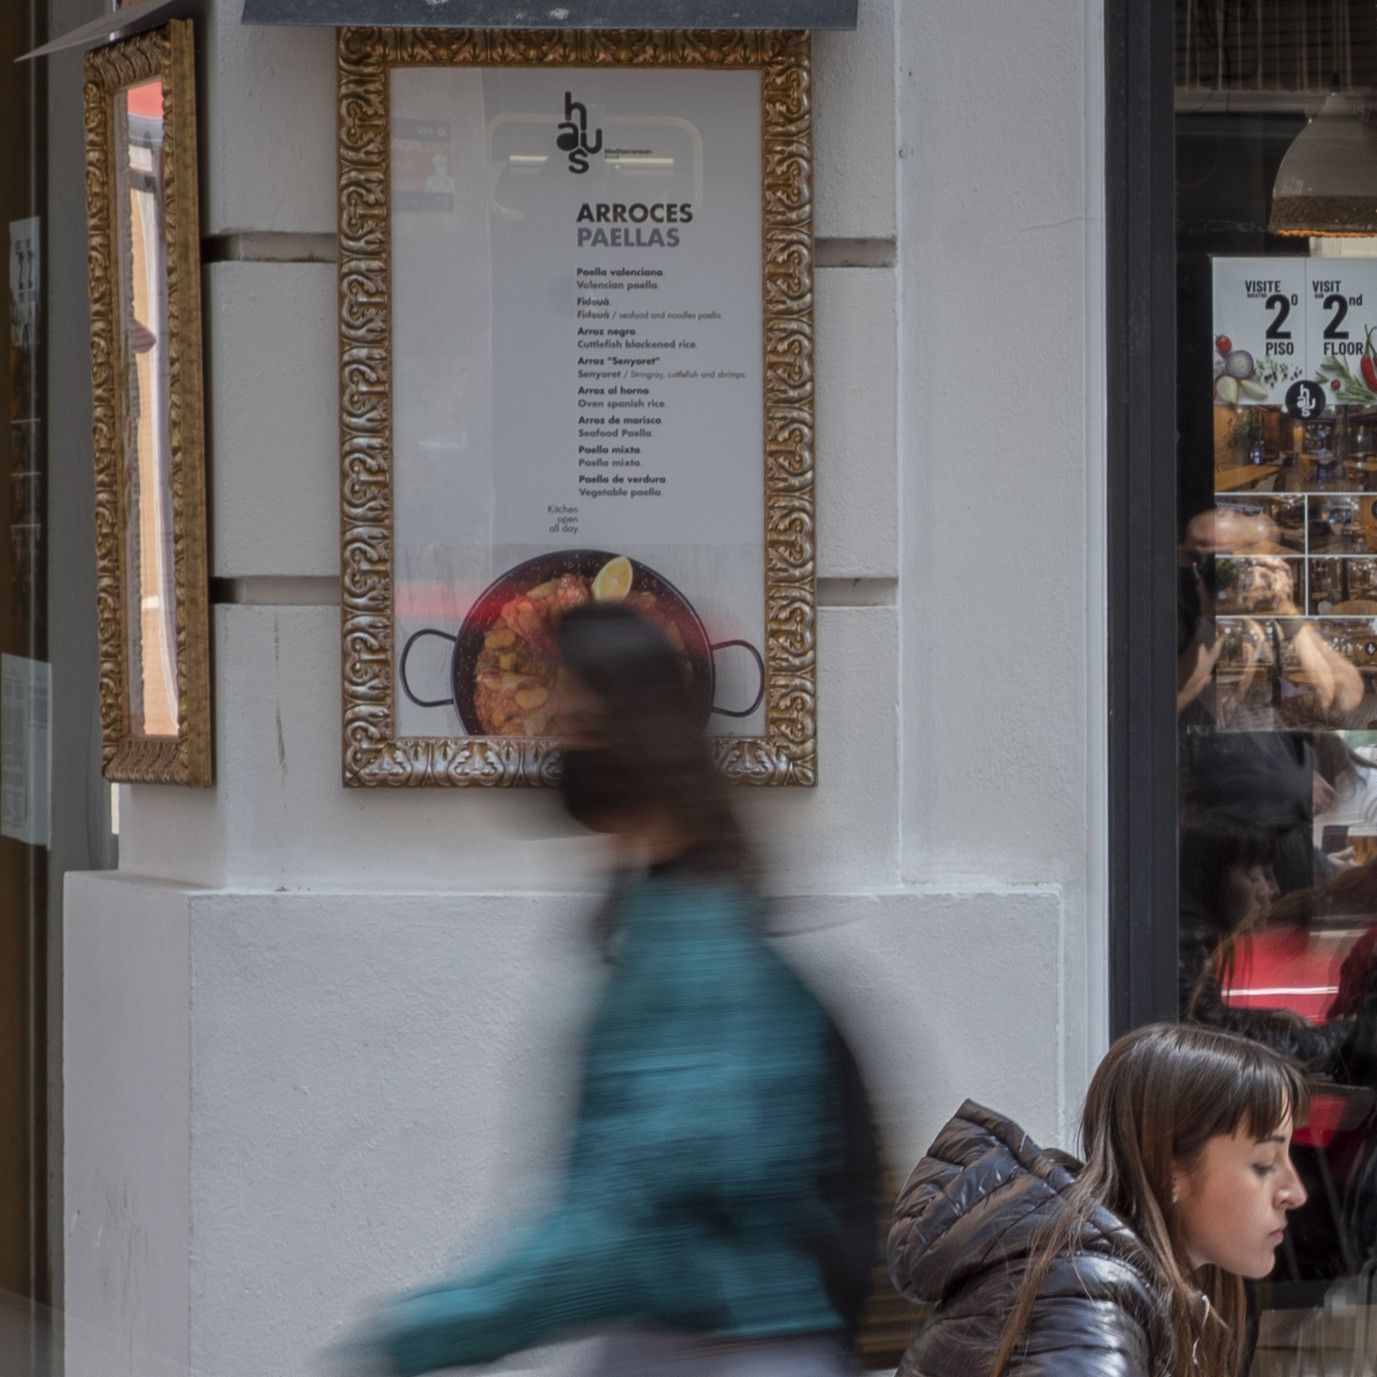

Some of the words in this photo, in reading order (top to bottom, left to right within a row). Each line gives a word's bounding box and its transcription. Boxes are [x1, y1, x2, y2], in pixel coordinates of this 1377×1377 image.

[576, 203, 693, 223] ARROCES
[577, 227, 680, 248] PAELLAS
[577, 267, 607, 277] Paella
[577, 280, 625, 290] Valencian
[1245, 280, 1281, 293] VISITE
[1312, 280, 1342, 293] VISIT
[651, 310, 665, 319] and
[667, 310, 696, 319] noodles
[1323, 294, 1363, 339] 2nd
[577, 327, 605, 336] Arroz
[577, 339, 623, 349] Cuttlefish
[625, 339, 676, 349] blackened
[1265, 342, 1294, 355] PISO
[1323, 342, 1363, 355] FLOOR
[577, 356, 605, 366] Arroz
[577, 370, 621, 381] Senyoret
[701, 370, 715, 379] and
[577, 386, 605, 395] Arroz
[608, 386, 617, 395] al
[577, 399, 604, 408] Oven
[607, 399, 644, 409] spanish
[577, 416, 605, 425] Arroz
[608, 416, 620, 425] de
[578, 429, 618, 437] Seafood
[578, 445, 609, 454] Paella
[578, 458, 609, 467] Paella
[578, 475, 609, 484] Paella
[612, 475, 624, 484] de
[579, 487, 627, 498] Vegetable
[547, 505, 578, 514] Kitchen
[556, 516, 578, 524] open
[549, 524, 559, 533] all
